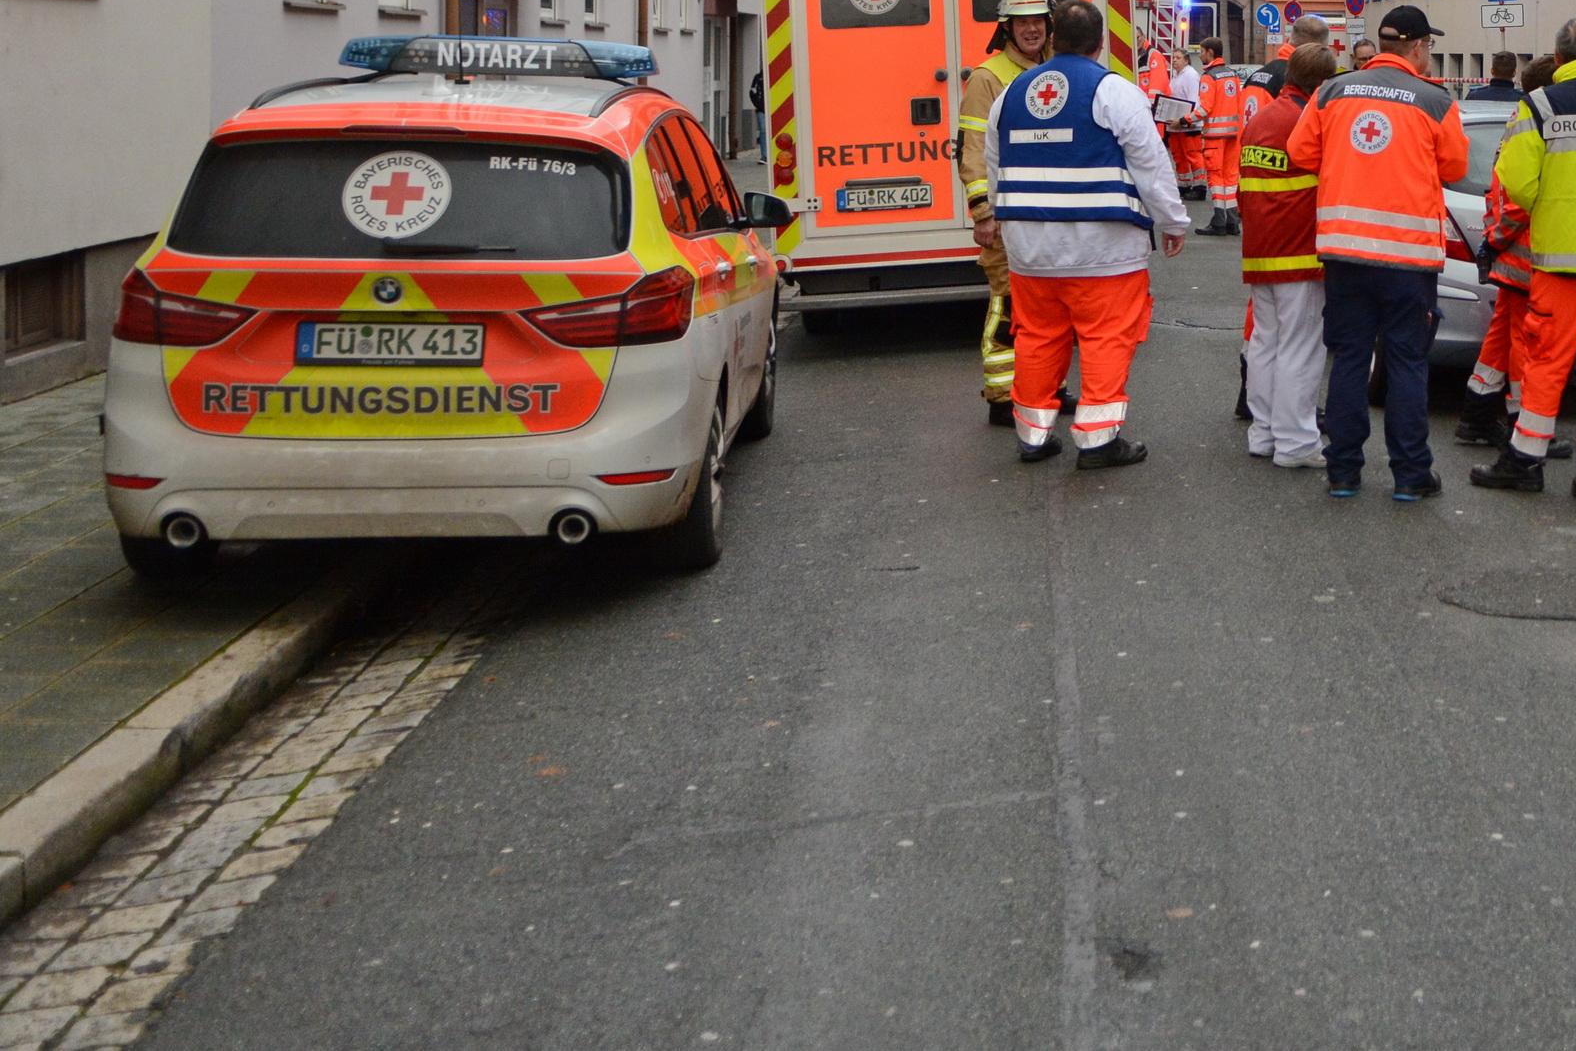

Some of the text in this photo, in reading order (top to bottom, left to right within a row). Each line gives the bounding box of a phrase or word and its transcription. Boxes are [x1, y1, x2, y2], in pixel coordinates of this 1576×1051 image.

[437, 42, 557, 70] NOTARZT
[1343, 85, 1416, 103] BEREITSCHAFTEN
[353, 156, 444, 190] BAYERISCHES
[489, 156, 576, 175] RK-Fü 76/3
[847, 188, 929, 206] FÜ RK 402
[351, 195, 442, 232] ROTES KREUZ
[315, 328, 356, 355] FÜ
[376, 328, 416, 355] RK
[422, 328, 479, 355] 413
[203, 384, 558, 414] RETTUNGSDIENST
